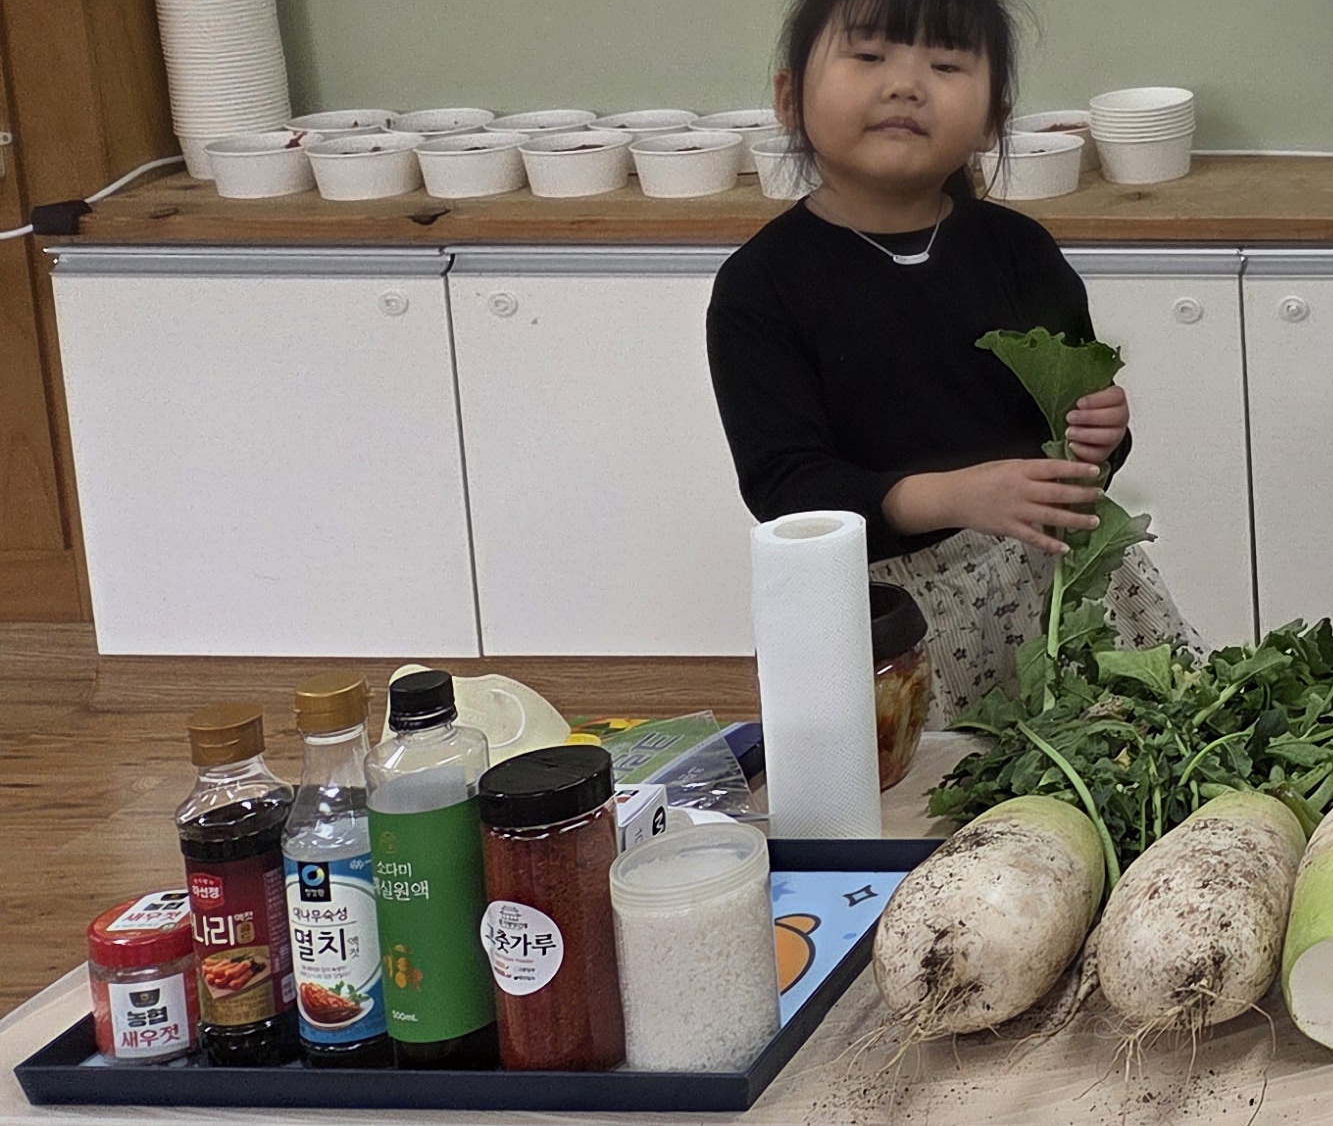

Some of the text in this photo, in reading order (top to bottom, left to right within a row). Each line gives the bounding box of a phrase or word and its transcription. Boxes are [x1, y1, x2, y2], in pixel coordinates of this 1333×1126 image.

[376, 861, 412, 878] 소다미
[191, 884, 220, 899] 하선정
[122, 910, 182, 922] 새우젓
[293, 906, 348, 923] 대나무숙성
[190, 911, 236, 946] 나리
[293, 927, 347, 962] 멸치
[127, 1006, 169, 1028] 농협
[121, 1023, 180, 1049] 새우젓
